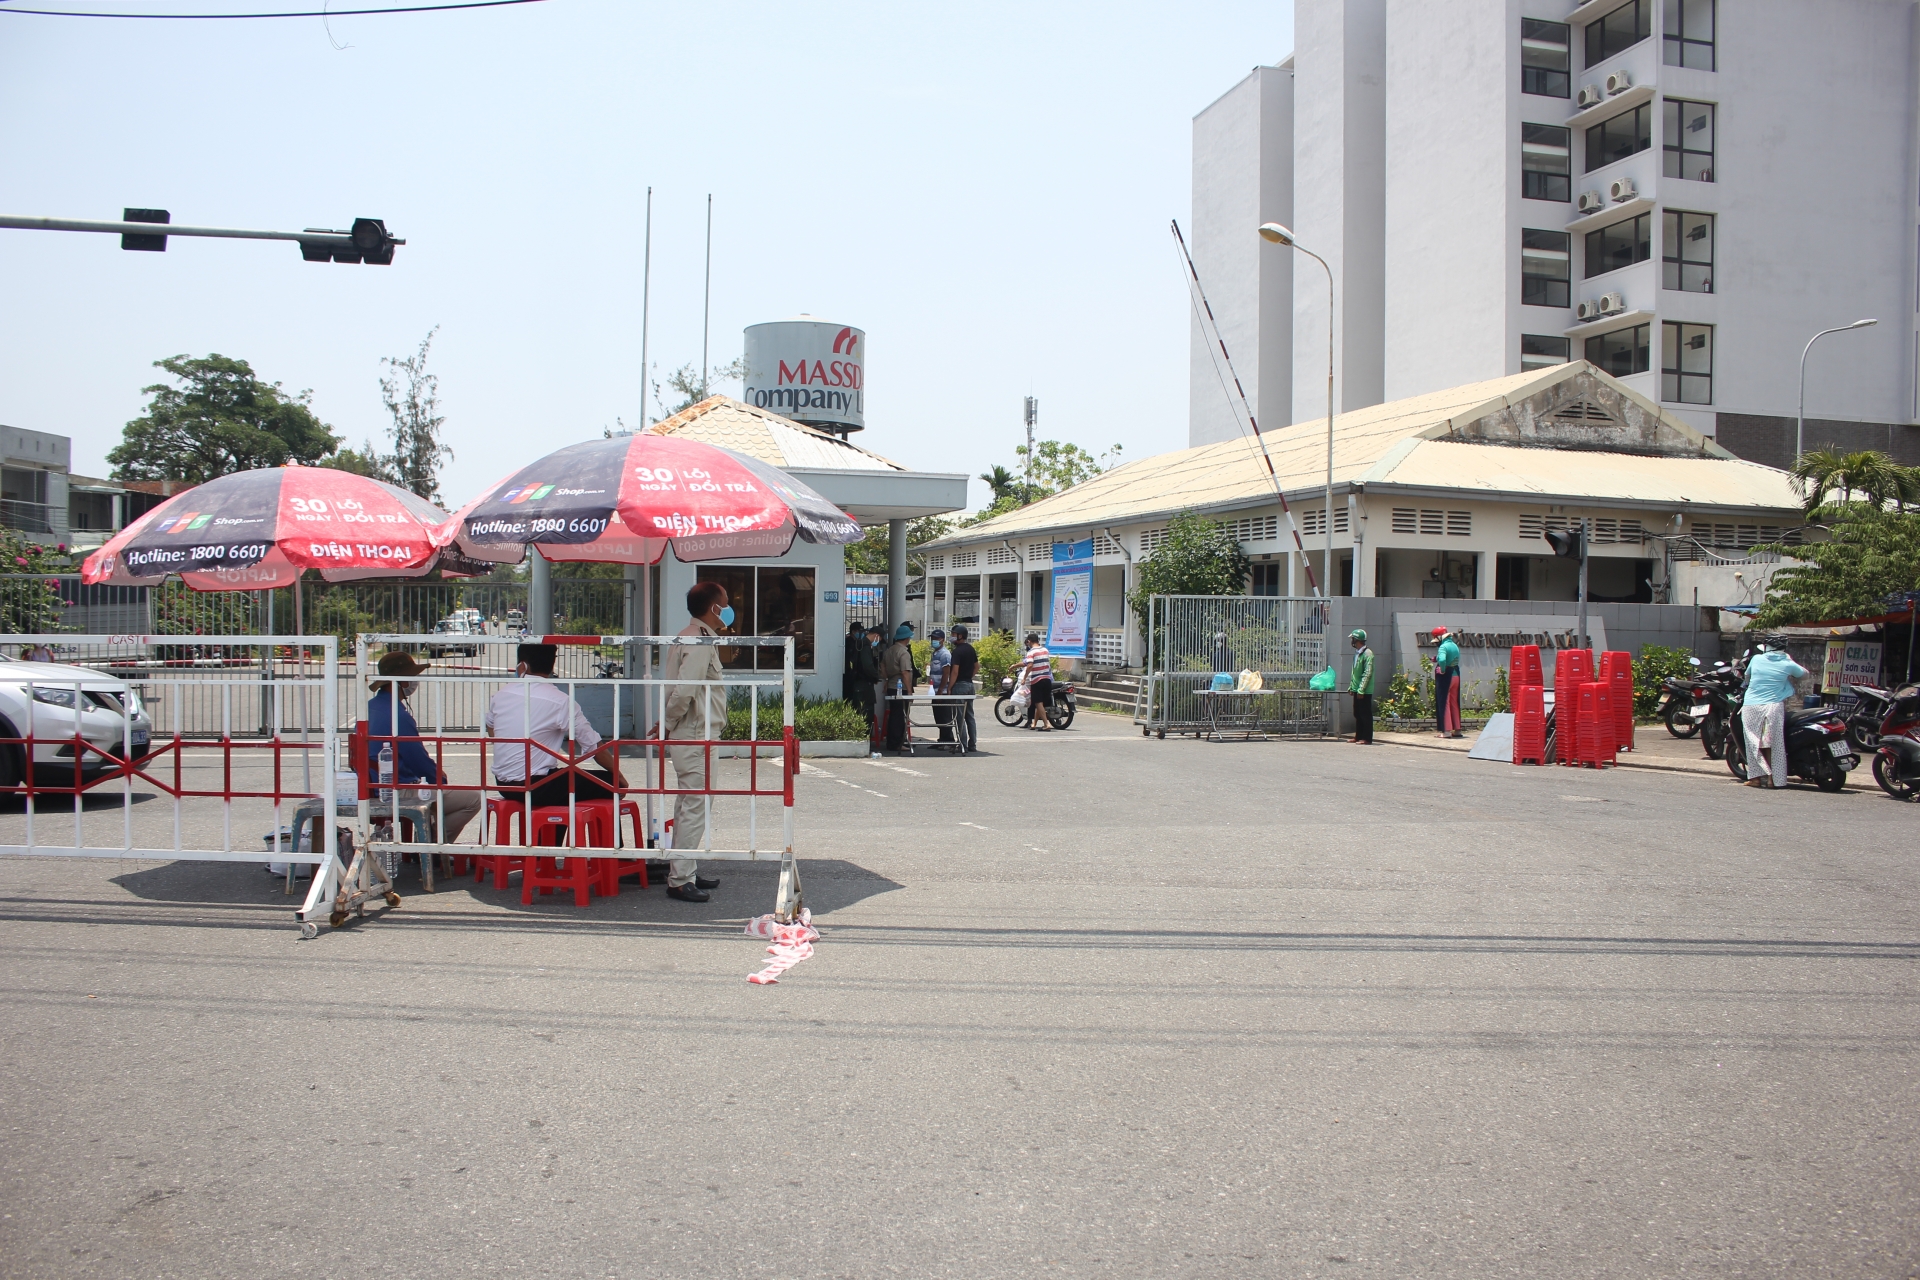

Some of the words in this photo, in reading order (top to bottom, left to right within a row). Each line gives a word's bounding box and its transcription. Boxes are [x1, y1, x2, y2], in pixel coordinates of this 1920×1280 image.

[778, 359, 863, 390] MASSD
[745, 387, 852, 416] Company
[635, 467, 674, 482] 30
[502, 486, 553, 500] FPT
[640, 482, 677, 491] NGÀY
[689, 479, 722, 492] ĐỔI
[725, 481, 758, 493] TRẢ
[290, 498, 328, 512] 30
[158, 515, 210, 532] FPT
[296, 513, 331, 521] NGÀY
[343, 510, 374, 523] ĐỔI
[377, 511, 409, 523] TRẢ
[471, 520, 526, 536] Hotline:
[531, 518, 565, 532] 1800
[569, 518, 607, 533] 6601
[836, 523, 860, 534] 6601
[129, 548, 185, 566] Hotline:
[190, 546, 224, 560] 1800
[229, 545, 266, 559] 6601
[310, 541, 353, 560] ĐIỆN
[356, 544, 411, 562] THOẠI
[1846, 644, 1879, 660] CHÂU
[1845, 663, 1859, 672] sơn
[1861, 662, 1875, 673] sửa
[1842, 674, 1875, 685] HONDA
